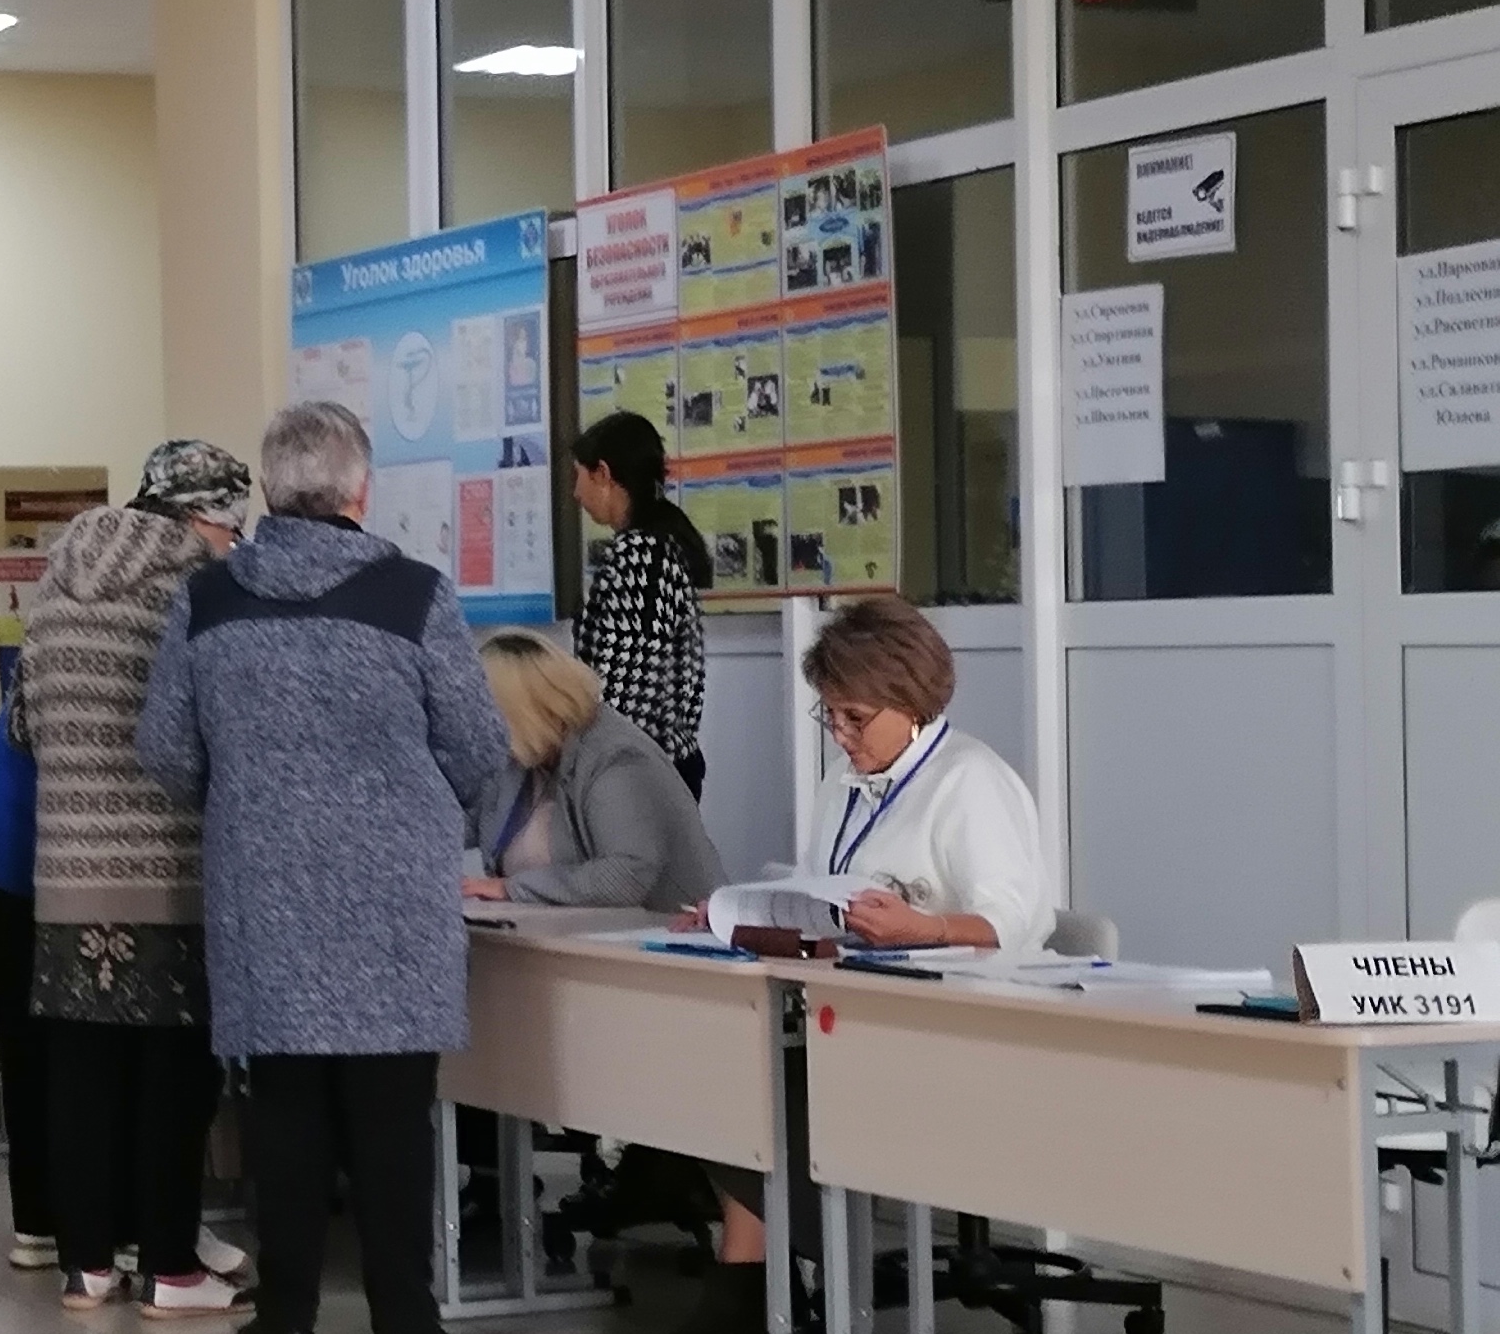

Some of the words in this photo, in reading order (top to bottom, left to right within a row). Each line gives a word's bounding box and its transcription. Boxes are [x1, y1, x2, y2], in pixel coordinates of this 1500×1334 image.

[1136, 153, 1194, 179] ВНИМАНИЕ!
[341, 259, 399, 292] Уголок
[401, 238, 486, 283] здоровья
[1352, 956, 1456, 977] ЧЛЕНЫ
[1351, 995, 1408, 1015] УИК
[1413, 994, 1476, 1016] 3191
